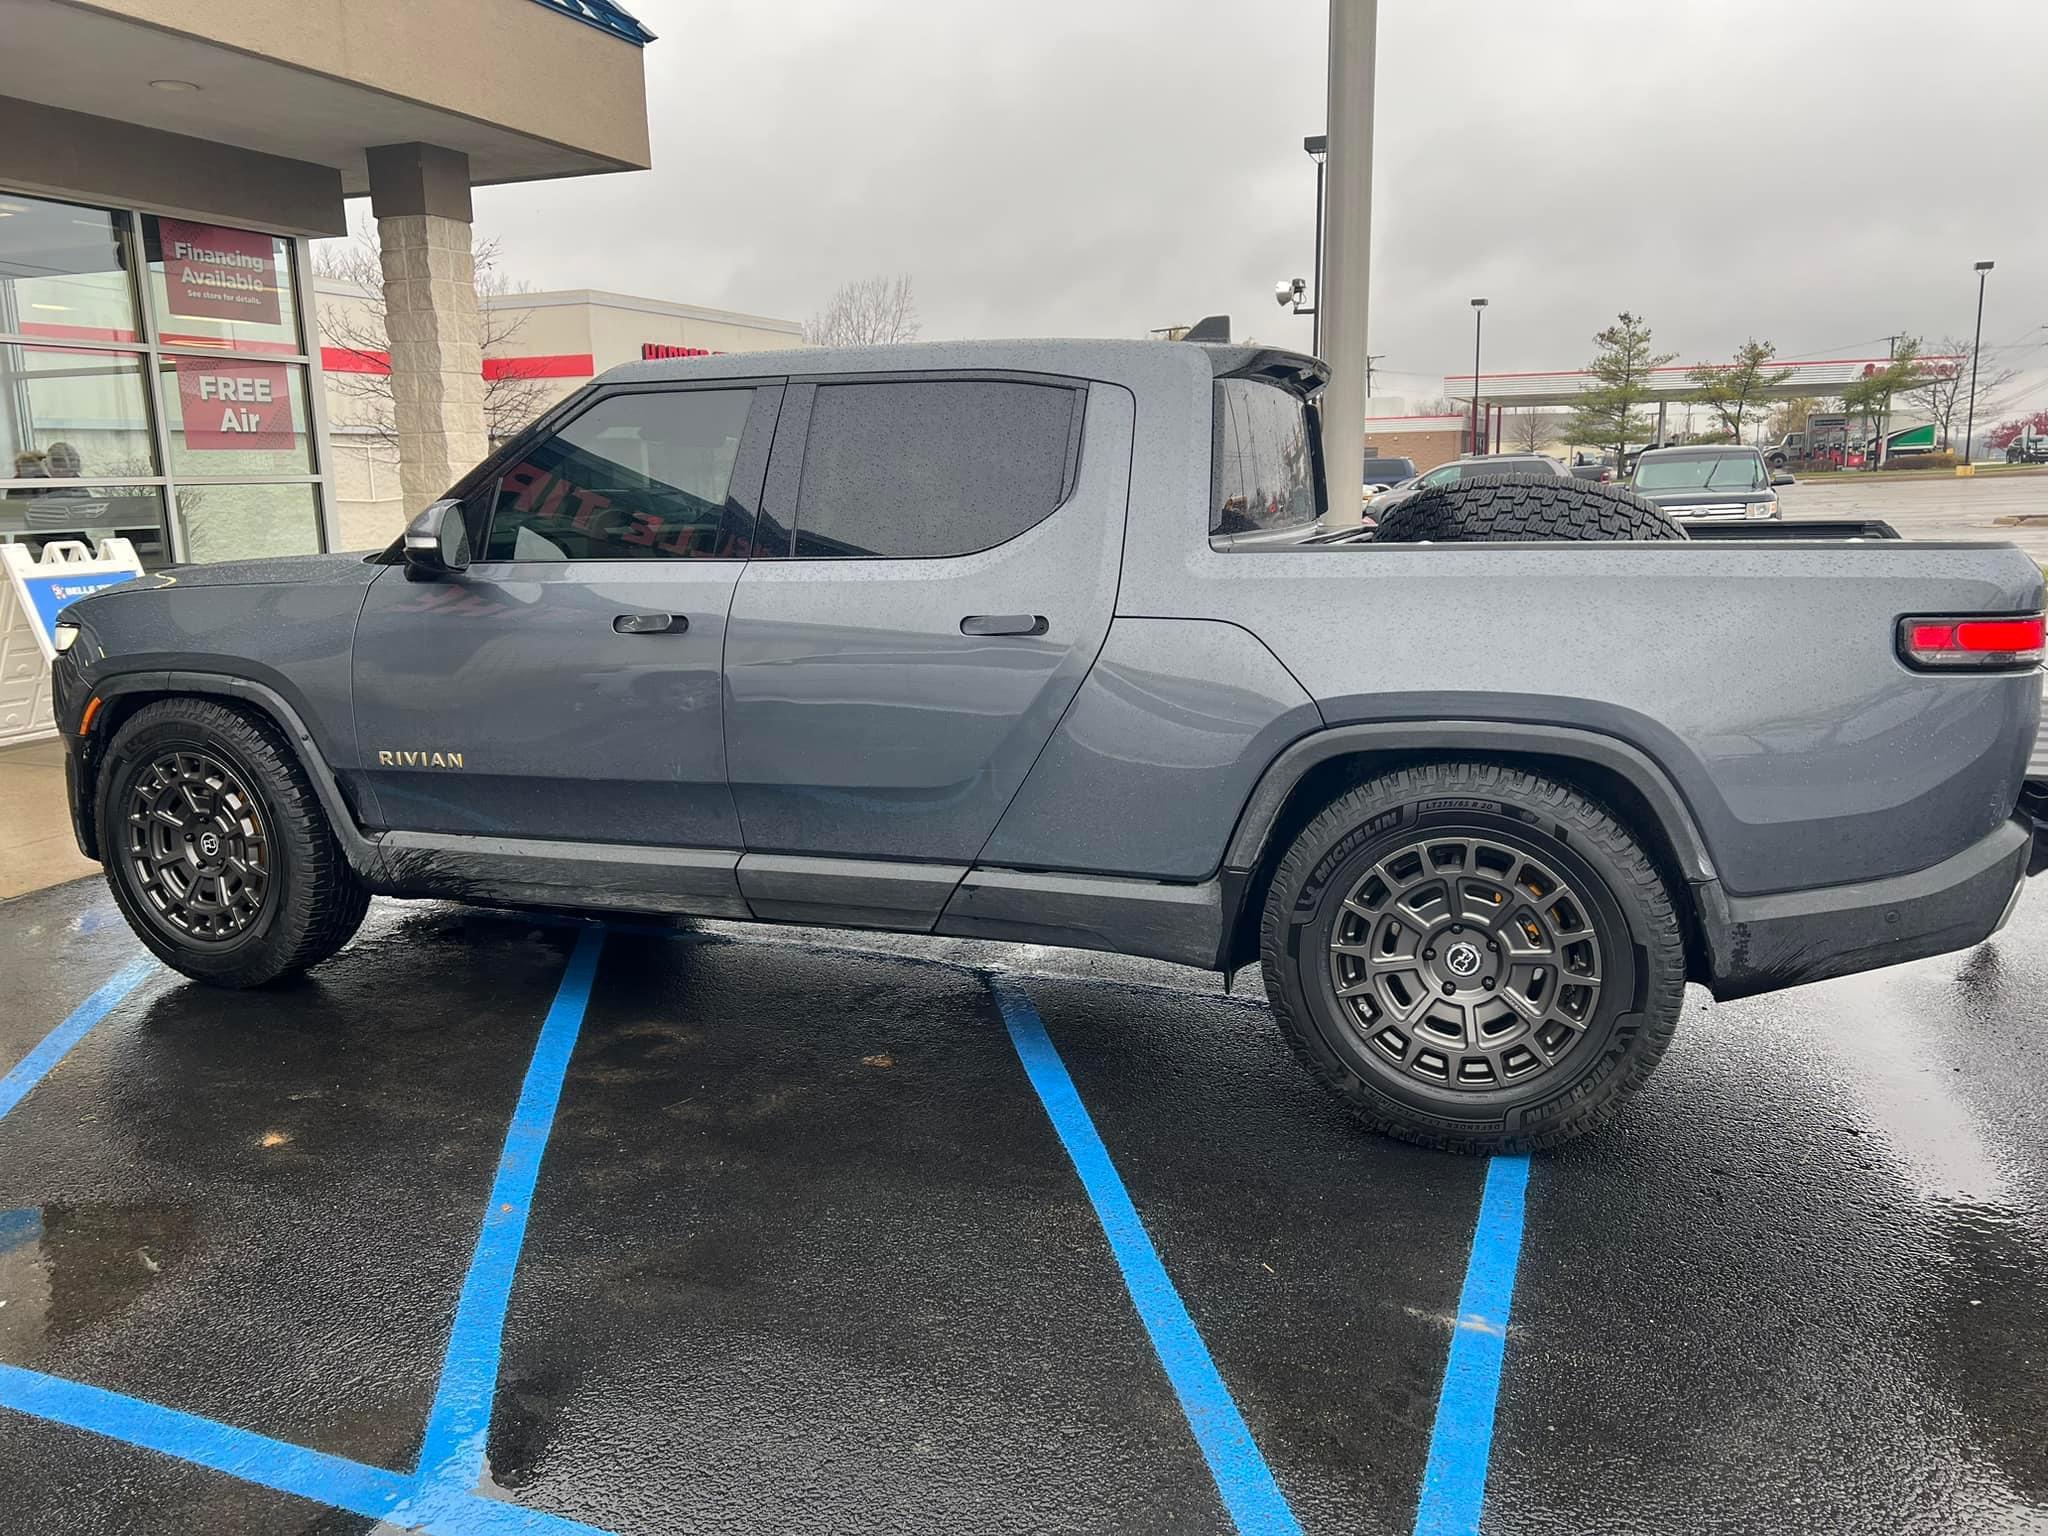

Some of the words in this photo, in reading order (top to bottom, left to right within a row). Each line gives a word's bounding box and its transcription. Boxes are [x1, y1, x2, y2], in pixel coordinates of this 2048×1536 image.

[174, 241, 264, 273] Financing
[181, 267, 264, 292] Available
[187, 289, 202, 298] See
[203, 291, 222, 301] store
[223, 292, 234, 301] for
[198, 375, 273, 403] FREE
[220, 408, 261, 433] Air
[378, 751, 465, 768] RIVIAN
[1314, 810, 1399, 882] MICHELIN
[1526, 1054, 1617, 1123] MICHELIN
